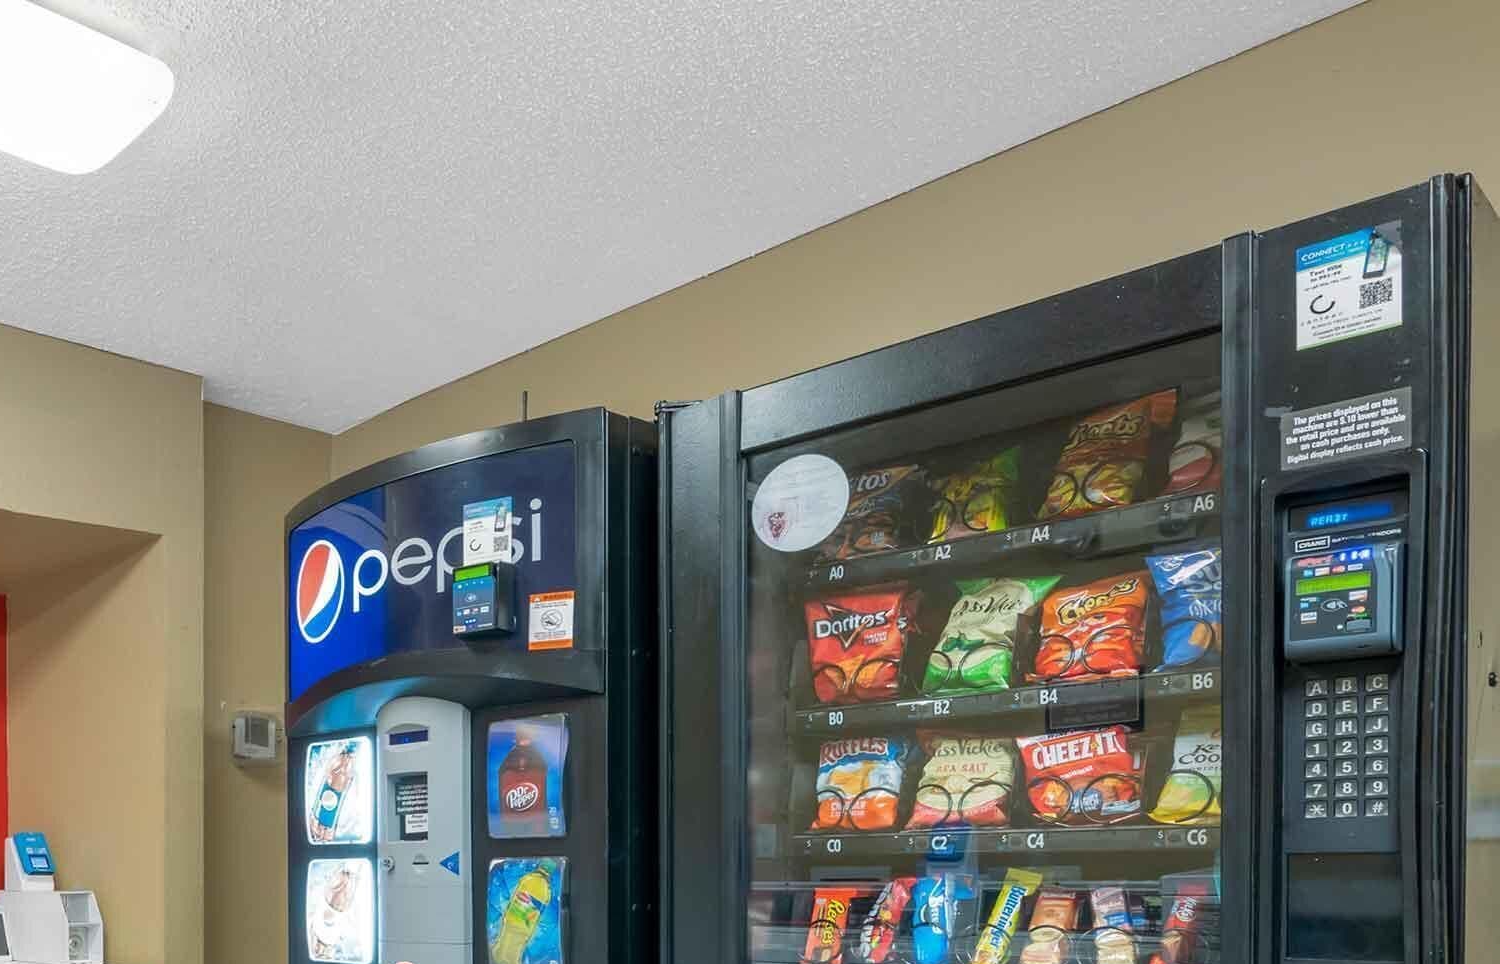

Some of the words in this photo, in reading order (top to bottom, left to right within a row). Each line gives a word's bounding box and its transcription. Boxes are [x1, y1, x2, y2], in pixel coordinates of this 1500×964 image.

[1193, 494, 1215, 512] A6
[1031, 525, 1050, 543] A4
[935, 545, 951, 560] A2
[829, 565, 844, 580] A0
[816, 610, 886, 638] Doritos
[1192, 672, 1213, 690] B6
[1312, 682, 1322, 695] A
[1342, 679, 1352, 692] B
[1372, 676, 1383, 689] C
[1039, 689, 1058, 704] B4
[934, 701, 950, 715] B2
[1312, 702, 1322, 715] D
[1342, 700, 1352, 713] E
[1373, 697, 1383, 711] F
[829, 712, 843, 725] B0
[1312, 722, 1322, 735] G
[1341, 720, 1352, 733] H
[1373, 718, 1383, 731] J
[1313, 743, 1321, 755] 1
[1342, 741, 1352, 753] 2
[1373, 739, 1382, 751] 3
[1312, 763, 1321, 775] 4
[1342, 761, 1352, 774] 5
[1373, 759, 1383, 772] 6
[1312, 783, 1322, 795] 7
[1342, 782, 1352, 794] 8
[1373, 780, 1383, 793] 9
[1342, 803, 1352, 815] 0
[1372, 801, 1383, 814] #
[932, 836, 948, 850] C2
[1027, 833, 1045, 849] C4
[1187, 829, 1208, 845] C6
[827, 840, 841, 853] C0
